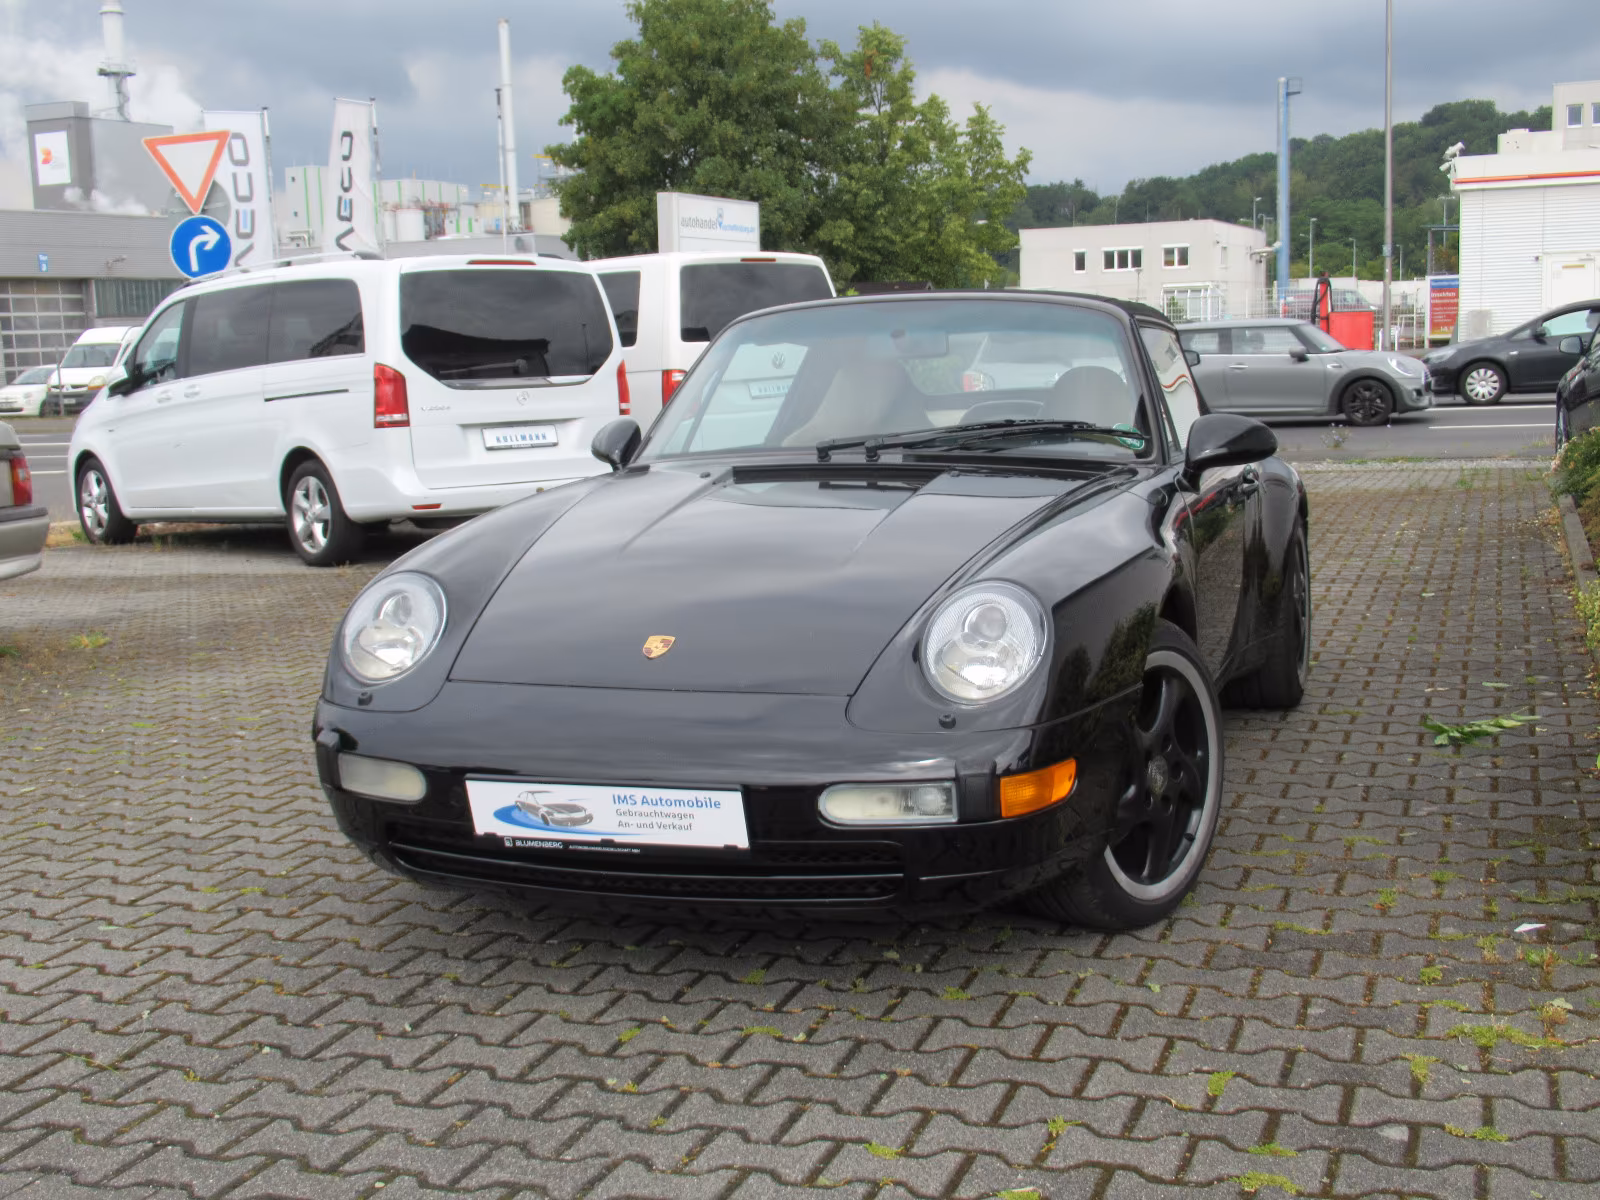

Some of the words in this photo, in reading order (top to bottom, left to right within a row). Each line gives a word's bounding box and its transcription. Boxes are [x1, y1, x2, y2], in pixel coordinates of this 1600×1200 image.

[680, 215, 718, 230] autohandel
[612, 793, 637, 806] IMS
[640, 795, 721, 809] Automobile
[615, 808, 695, 820] Gebrauchtwagen
[618, 820, 633, 829] An-
[636, 820, 654, 830] und
[656, 821, 693, 832] Verkauf
[515, 839, 564, 849] BLUMENBERG
